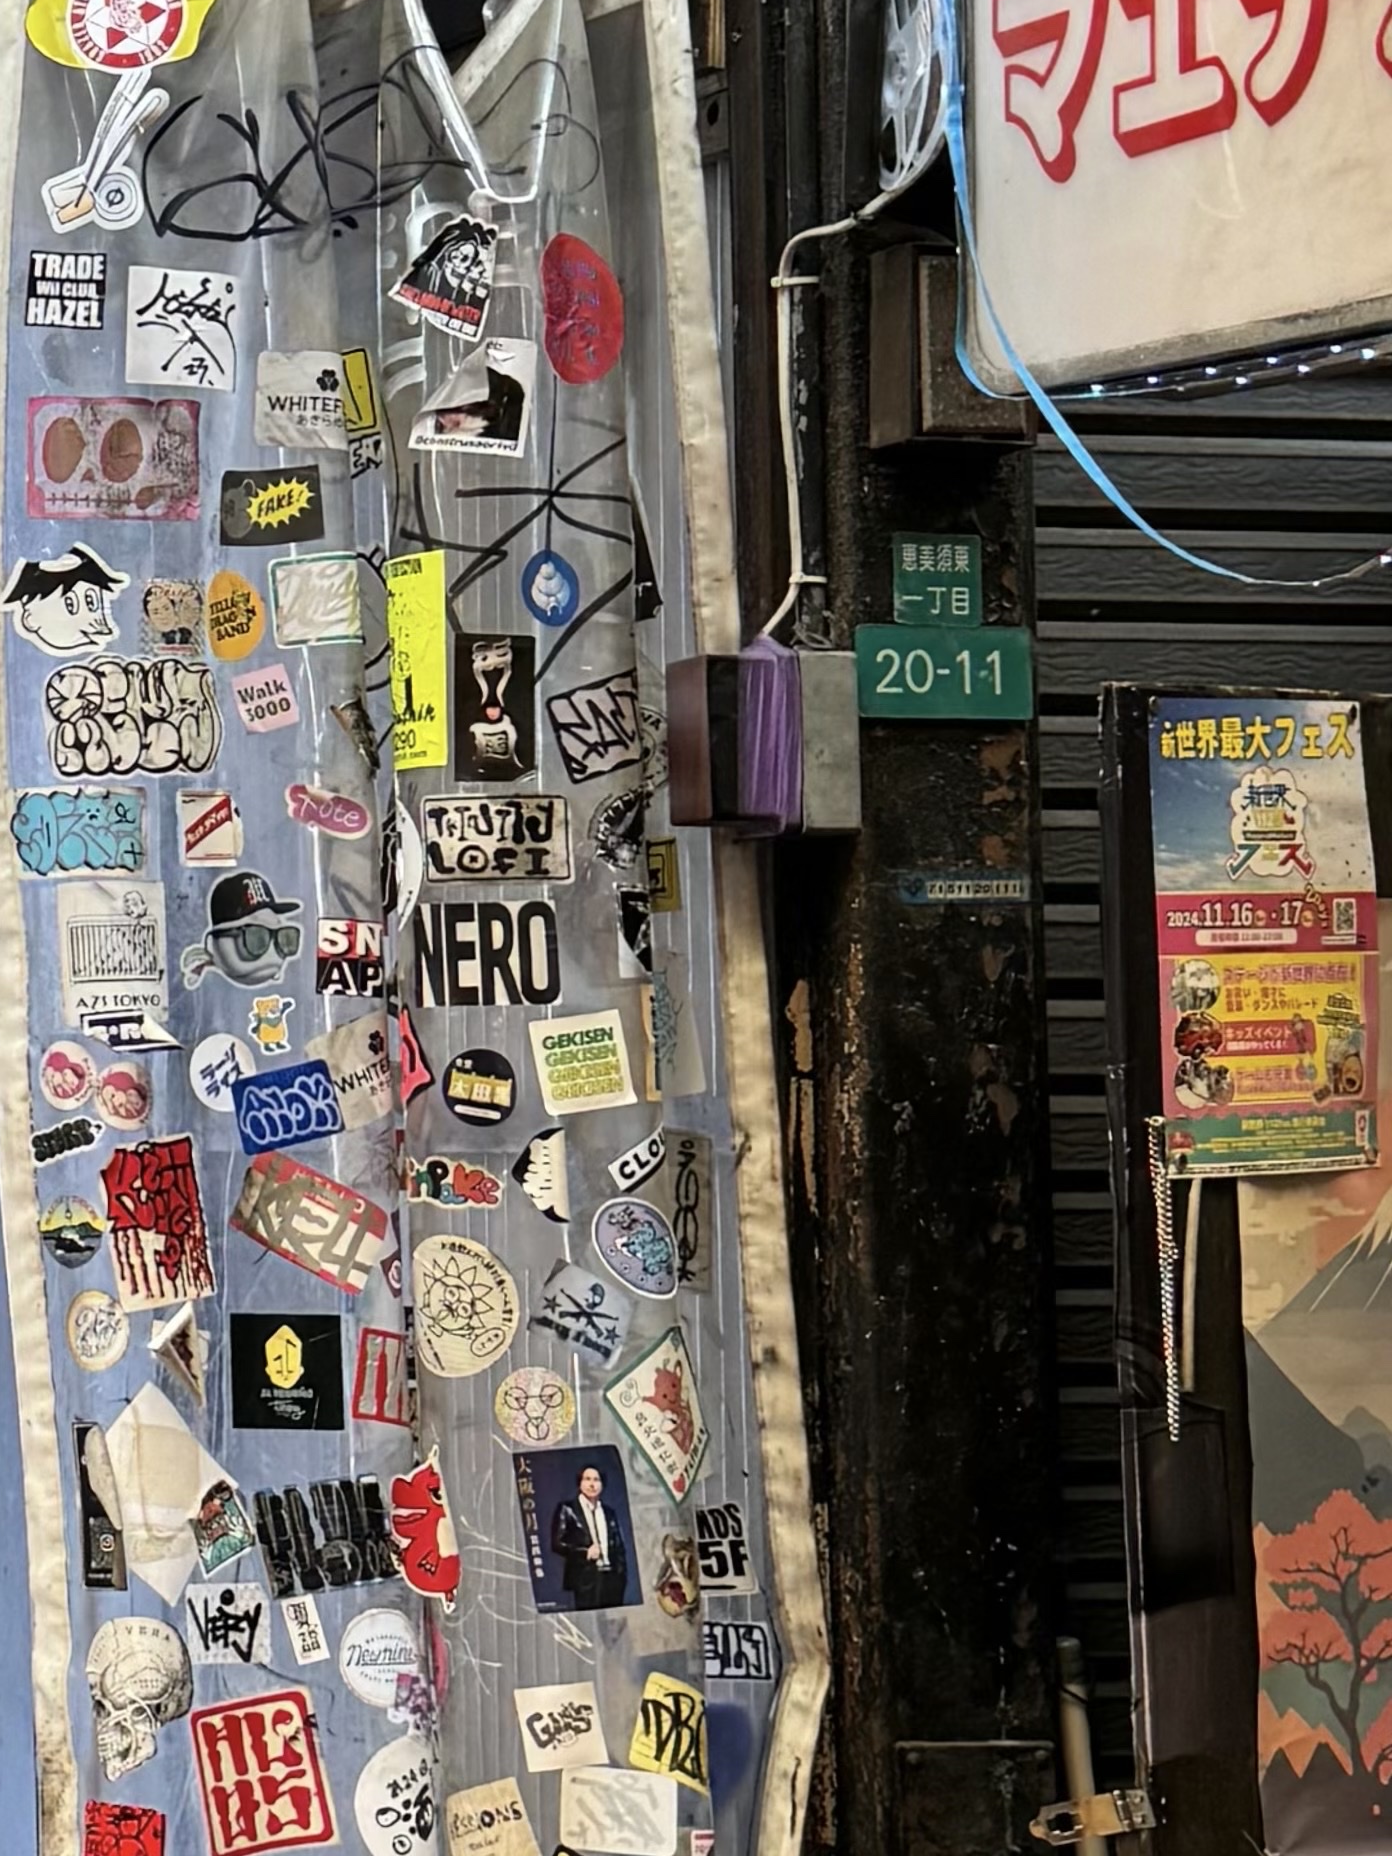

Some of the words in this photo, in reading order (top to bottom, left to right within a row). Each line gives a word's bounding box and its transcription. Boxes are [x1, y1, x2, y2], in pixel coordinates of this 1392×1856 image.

[30, 253, 105, 281] TRADE
[26, 297, 103, 328] HAZEL
[256, 488, 306, 519] FAKE!
[901, 586, 972, 616] 一丁目
[874, 648, 1004, 696] 20-11
[238, 681, 288, 704] Walk
[1160, 713, 1356, 761] 新世界最大フェス
[417, 900, 562, 1007] NERO
[541, 1026, 614, 1050] GEKISEN
[1225, 1025, 1291, 1039] キッズイベント
[544, 1045, 617, 1069] GEKISEN
